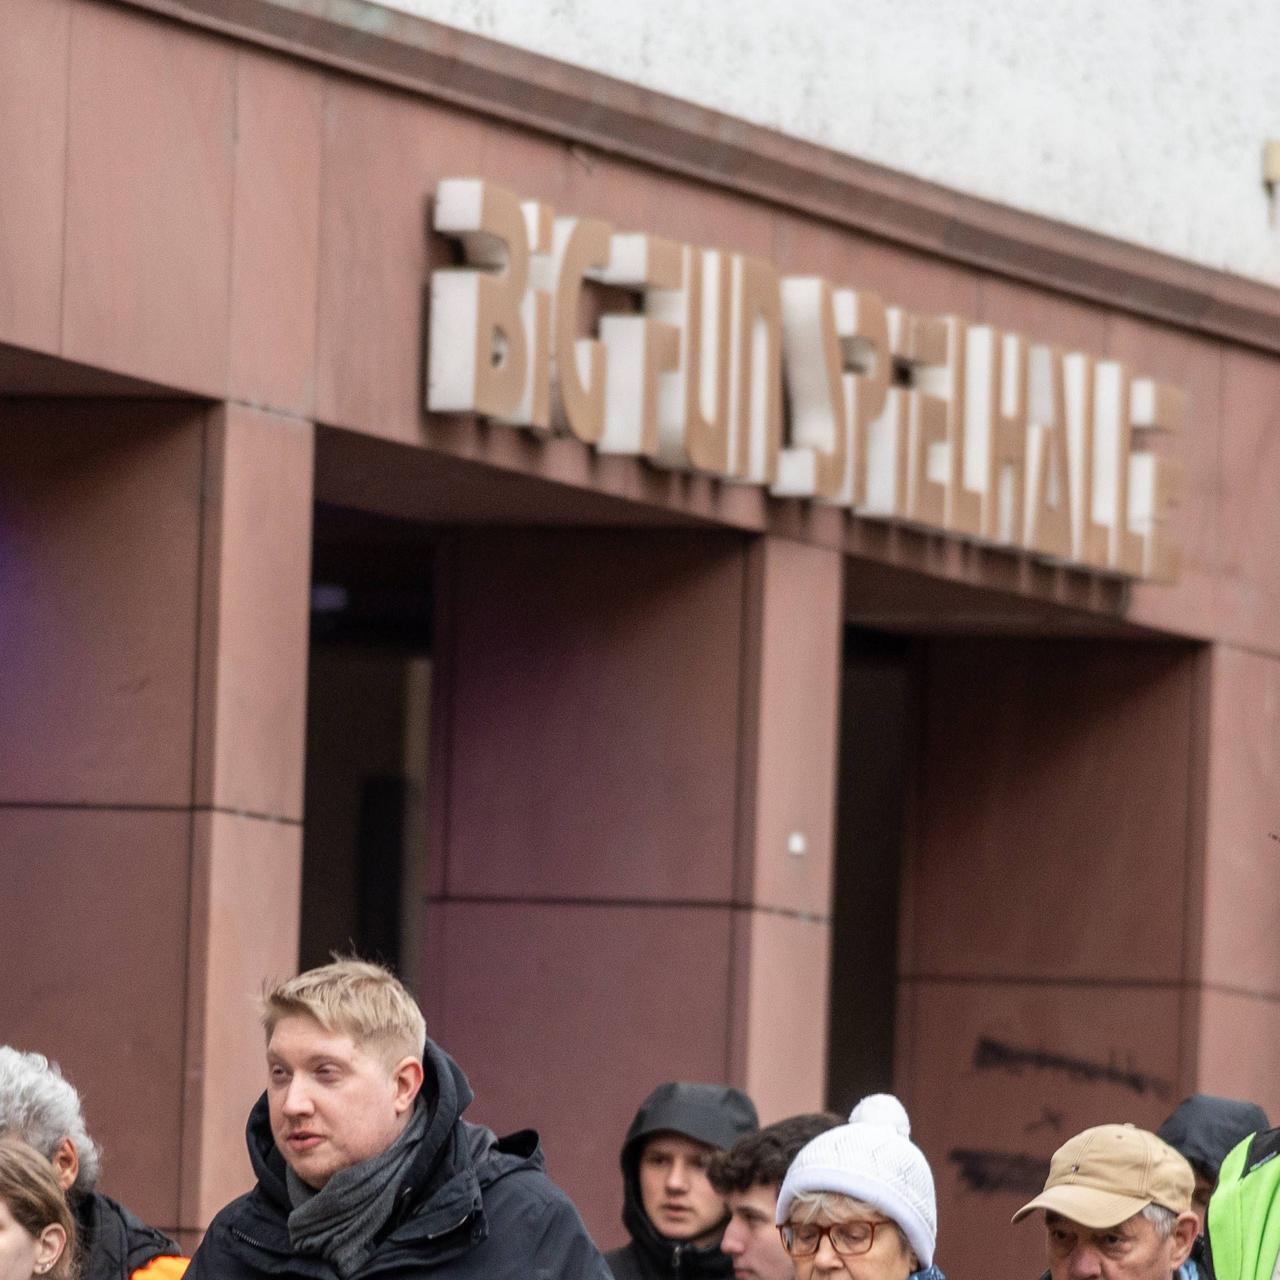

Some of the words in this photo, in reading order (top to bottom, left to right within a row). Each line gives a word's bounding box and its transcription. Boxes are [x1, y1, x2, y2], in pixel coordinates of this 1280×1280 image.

[426, 179, 613, 445] BIG
[597, 232, 784, 486] FUN
[771, 275, 1187, 588] SPIELHALLE
